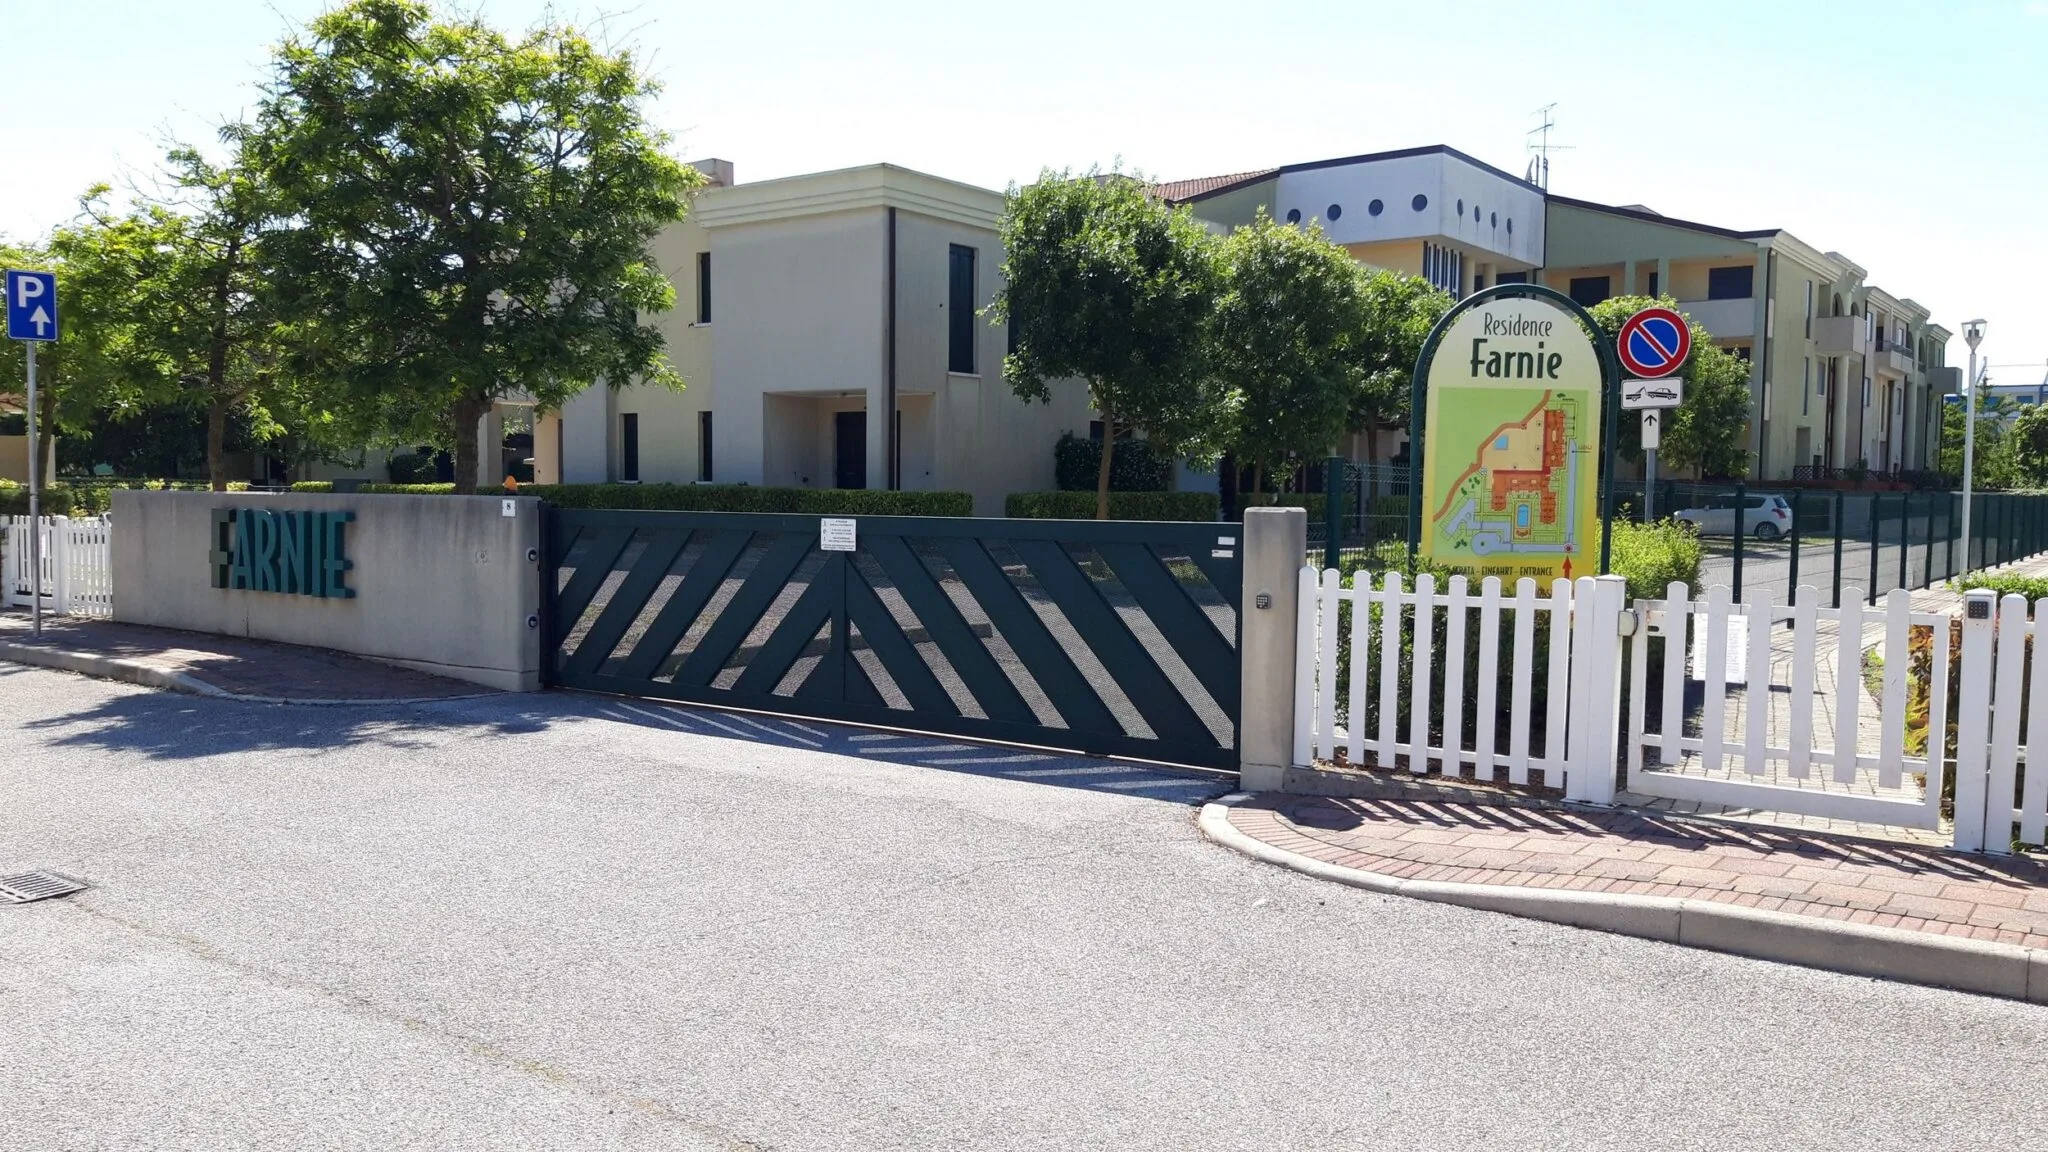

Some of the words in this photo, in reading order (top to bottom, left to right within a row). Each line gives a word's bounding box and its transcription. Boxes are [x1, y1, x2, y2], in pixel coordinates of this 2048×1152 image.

[17, 275, 45, 308] P
[1483, 312, 1553, 337] Residence
[1470, 338, 1563, 380] Farnie
[208, 508, 356, 599] FARNIE
[1481, 566, 1514, 577] EINFAHRT
[1519, 567, 1553, 577] ENTRANCE
